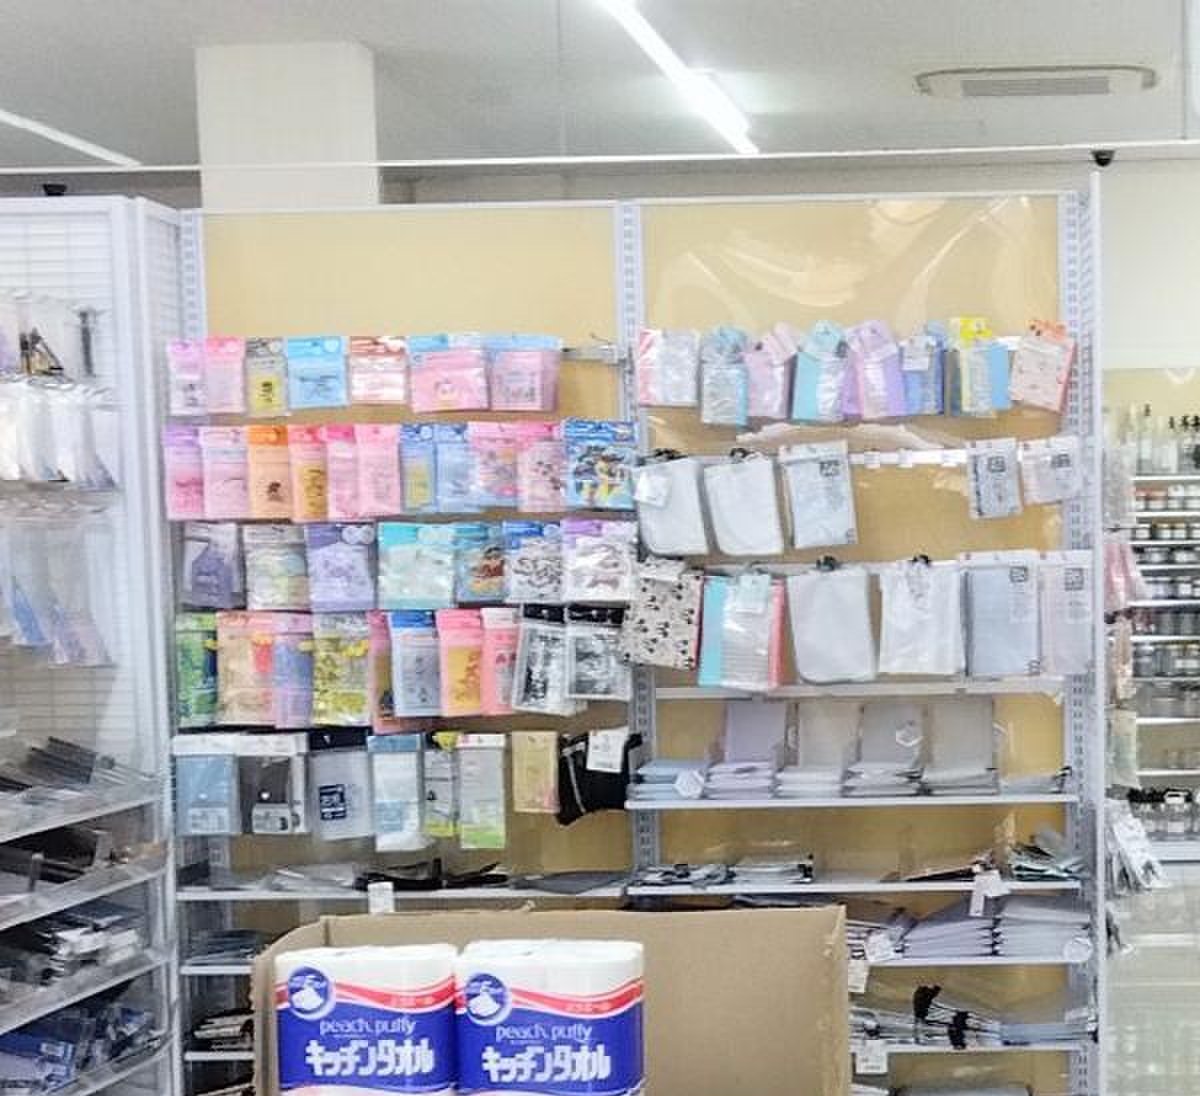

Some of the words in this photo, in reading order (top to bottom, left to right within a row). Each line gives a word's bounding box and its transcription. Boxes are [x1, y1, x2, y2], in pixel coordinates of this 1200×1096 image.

[319, 1018, 373, 1035] peach
[375, 1017, 417, 1037] puffy
[496, 1024, 550, 1042] peach
[551, 1024, 593, 1044] puffy
[305, 1038, 436, 1077] キッチンタオル
[482, 1044, 611, 1083] キッチンタオル
